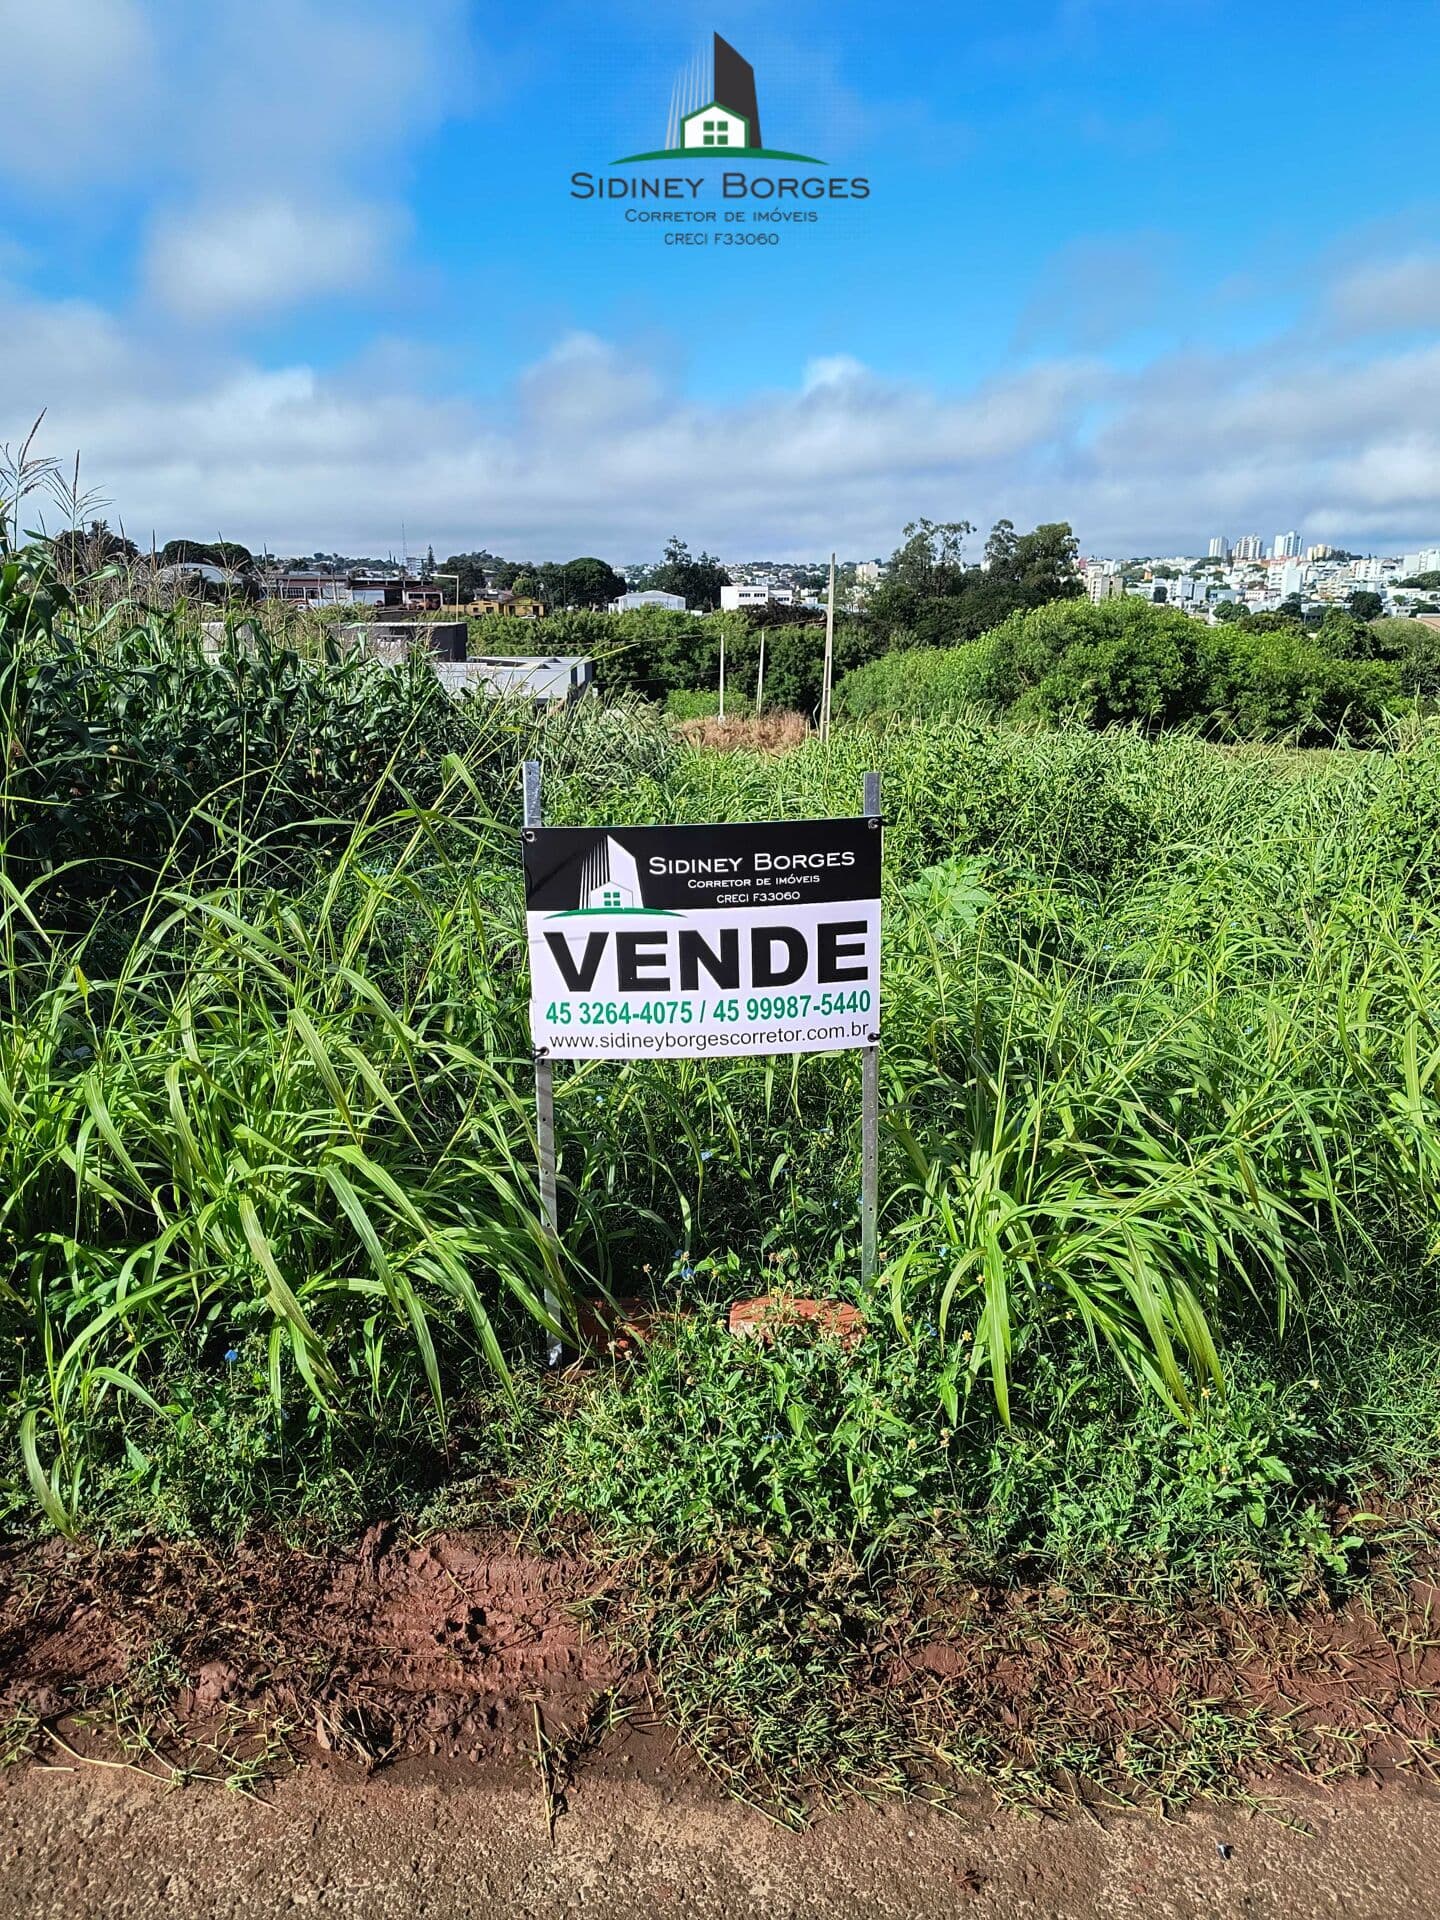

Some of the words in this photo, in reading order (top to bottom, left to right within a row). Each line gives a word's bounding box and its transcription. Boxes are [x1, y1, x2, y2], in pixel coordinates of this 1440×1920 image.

[649, 856, 743, 875] SIDINEY
[754, 851, 856, 870] BORGES
[687, 879, 751, 889] CORRETOR
[756, 878, 772, 886] DE
[775, 874, 820, 885] IMÓVEIS
[716, 893, 749, 904] CRECI
[753, 891, 800, 902] F33060
[542, 920, 868, 993] VENDE
[545, 1002, 572, 1024] 45
[579, 1000, 693, 1024] 3264-4075
[700, 1000, 706, 1023] /
[713, 999, 739, 1022] 45
[747, 990, 871, 1020] 99987-5440
[550, 1022, 868, 1052] www.sidineyborgescorretor.com.br
